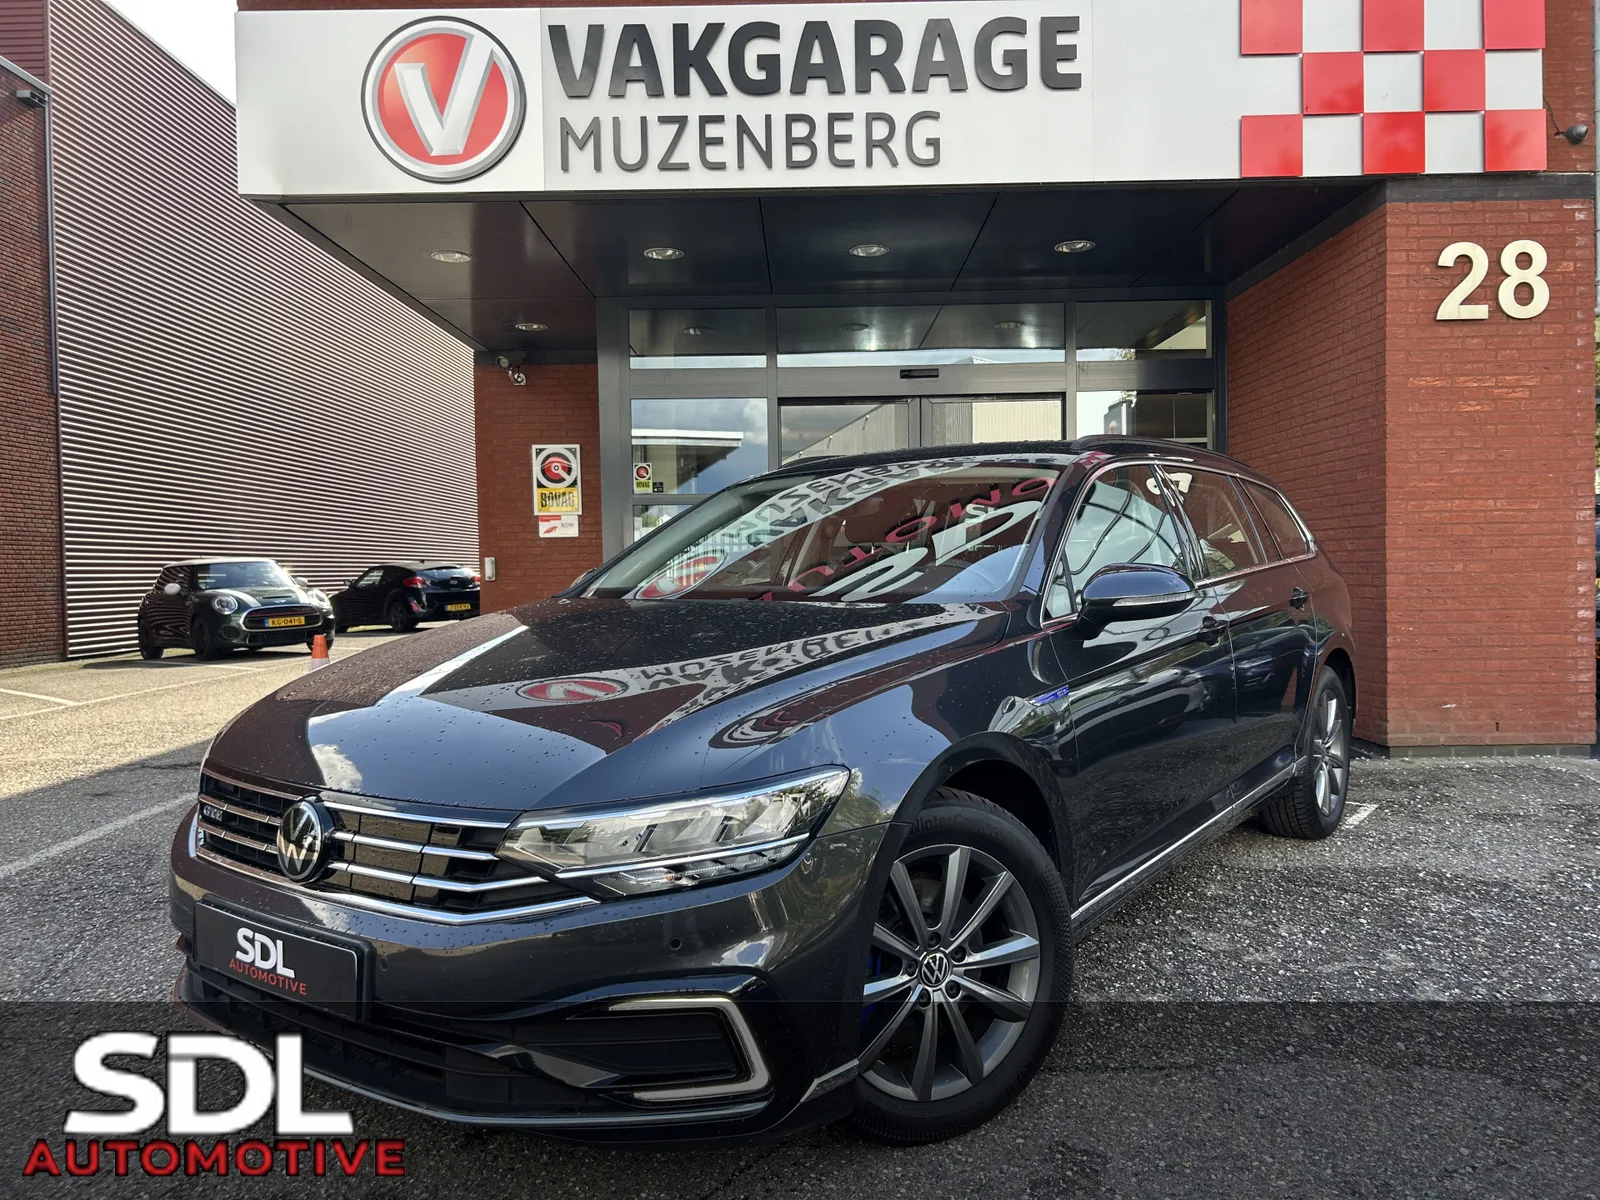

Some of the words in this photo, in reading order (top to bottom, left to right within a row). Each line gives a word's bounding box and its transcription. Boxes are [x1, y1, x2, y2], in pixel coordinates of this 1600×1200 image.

[547, 16, 1082, 98] VAKGARAGE
[560, 111, 941, 171] MUZENBERG
[1436, 239, 1550, 320] 28
[541, 491, 575, 508] BOVAG
[635, 481, 650, 489] BOVAG
[229, 957, 307, 996] AUTOMOTIVE
[235, 926, 295, 978] SDL
